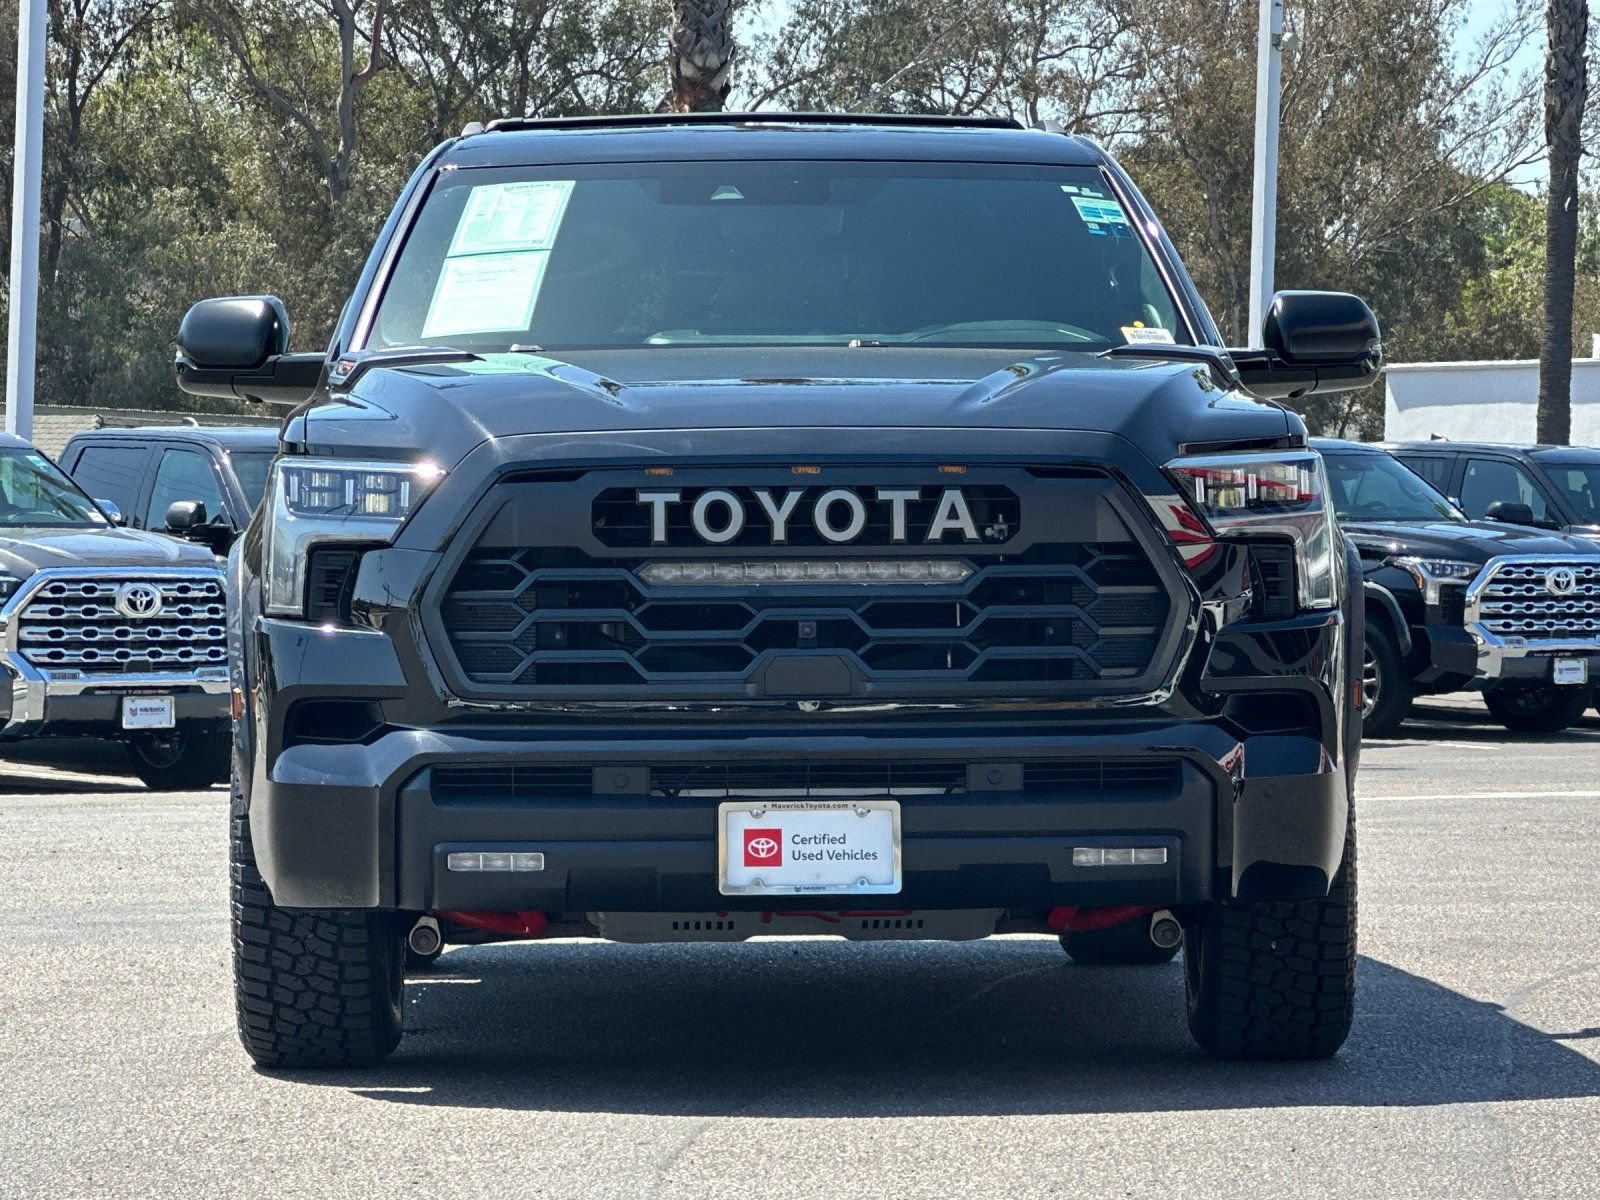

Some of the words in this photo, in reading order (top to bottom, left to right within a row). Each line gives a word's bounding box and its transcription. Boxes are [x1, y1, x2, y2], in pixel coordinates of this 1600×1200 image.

[637, 488, 981, 544] TOYOTA
[791, 834, 846, 845] Certified
[792, 851, 823, 861] Used
[826, 850, 878, 861] Vehicles
